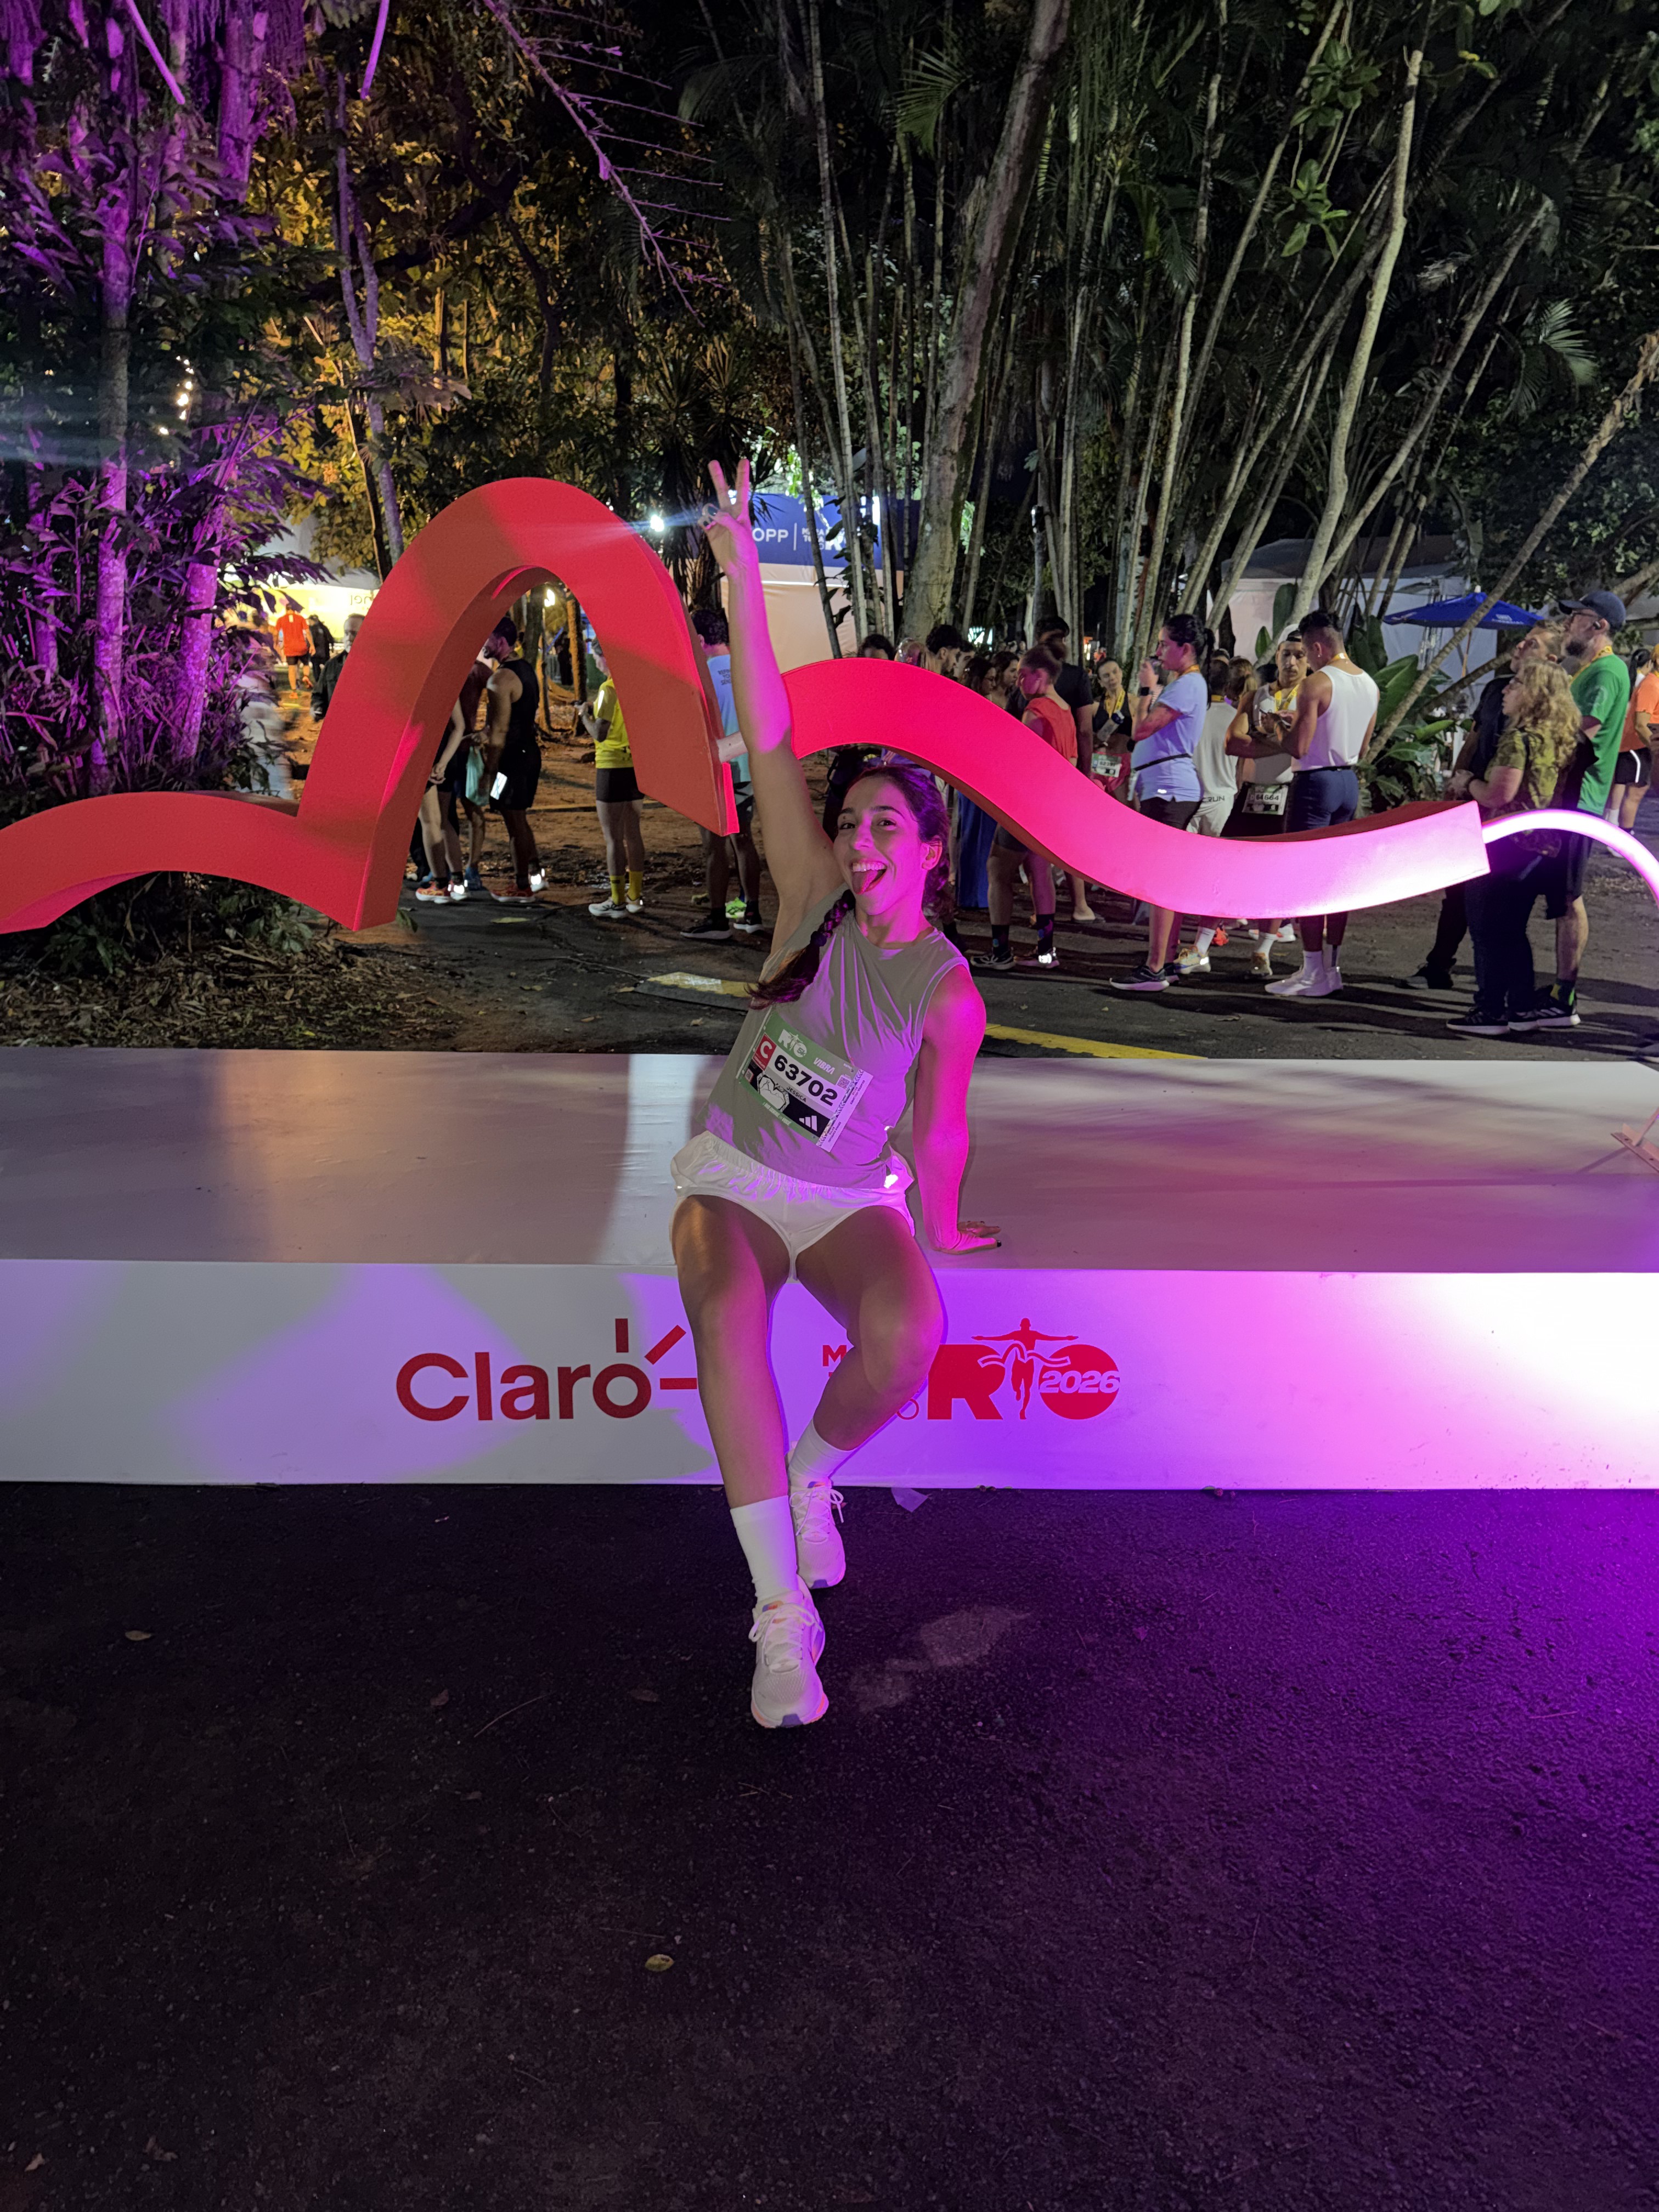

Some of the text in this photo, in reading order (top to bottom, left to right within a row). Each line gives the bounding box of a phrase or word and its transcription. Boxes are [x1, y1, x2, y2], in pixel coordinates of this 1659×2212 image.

[752, 528, 789, 542] OPP
[760, 1041, 838, 1107] C 63702
[814, 1057, 835, 1075] VIBRA
[786, 1086, 806, 1102] JESSICA
[396, 1352, 652, 1421] Claro
[1039, 1370, 1120, 1394] 2026
